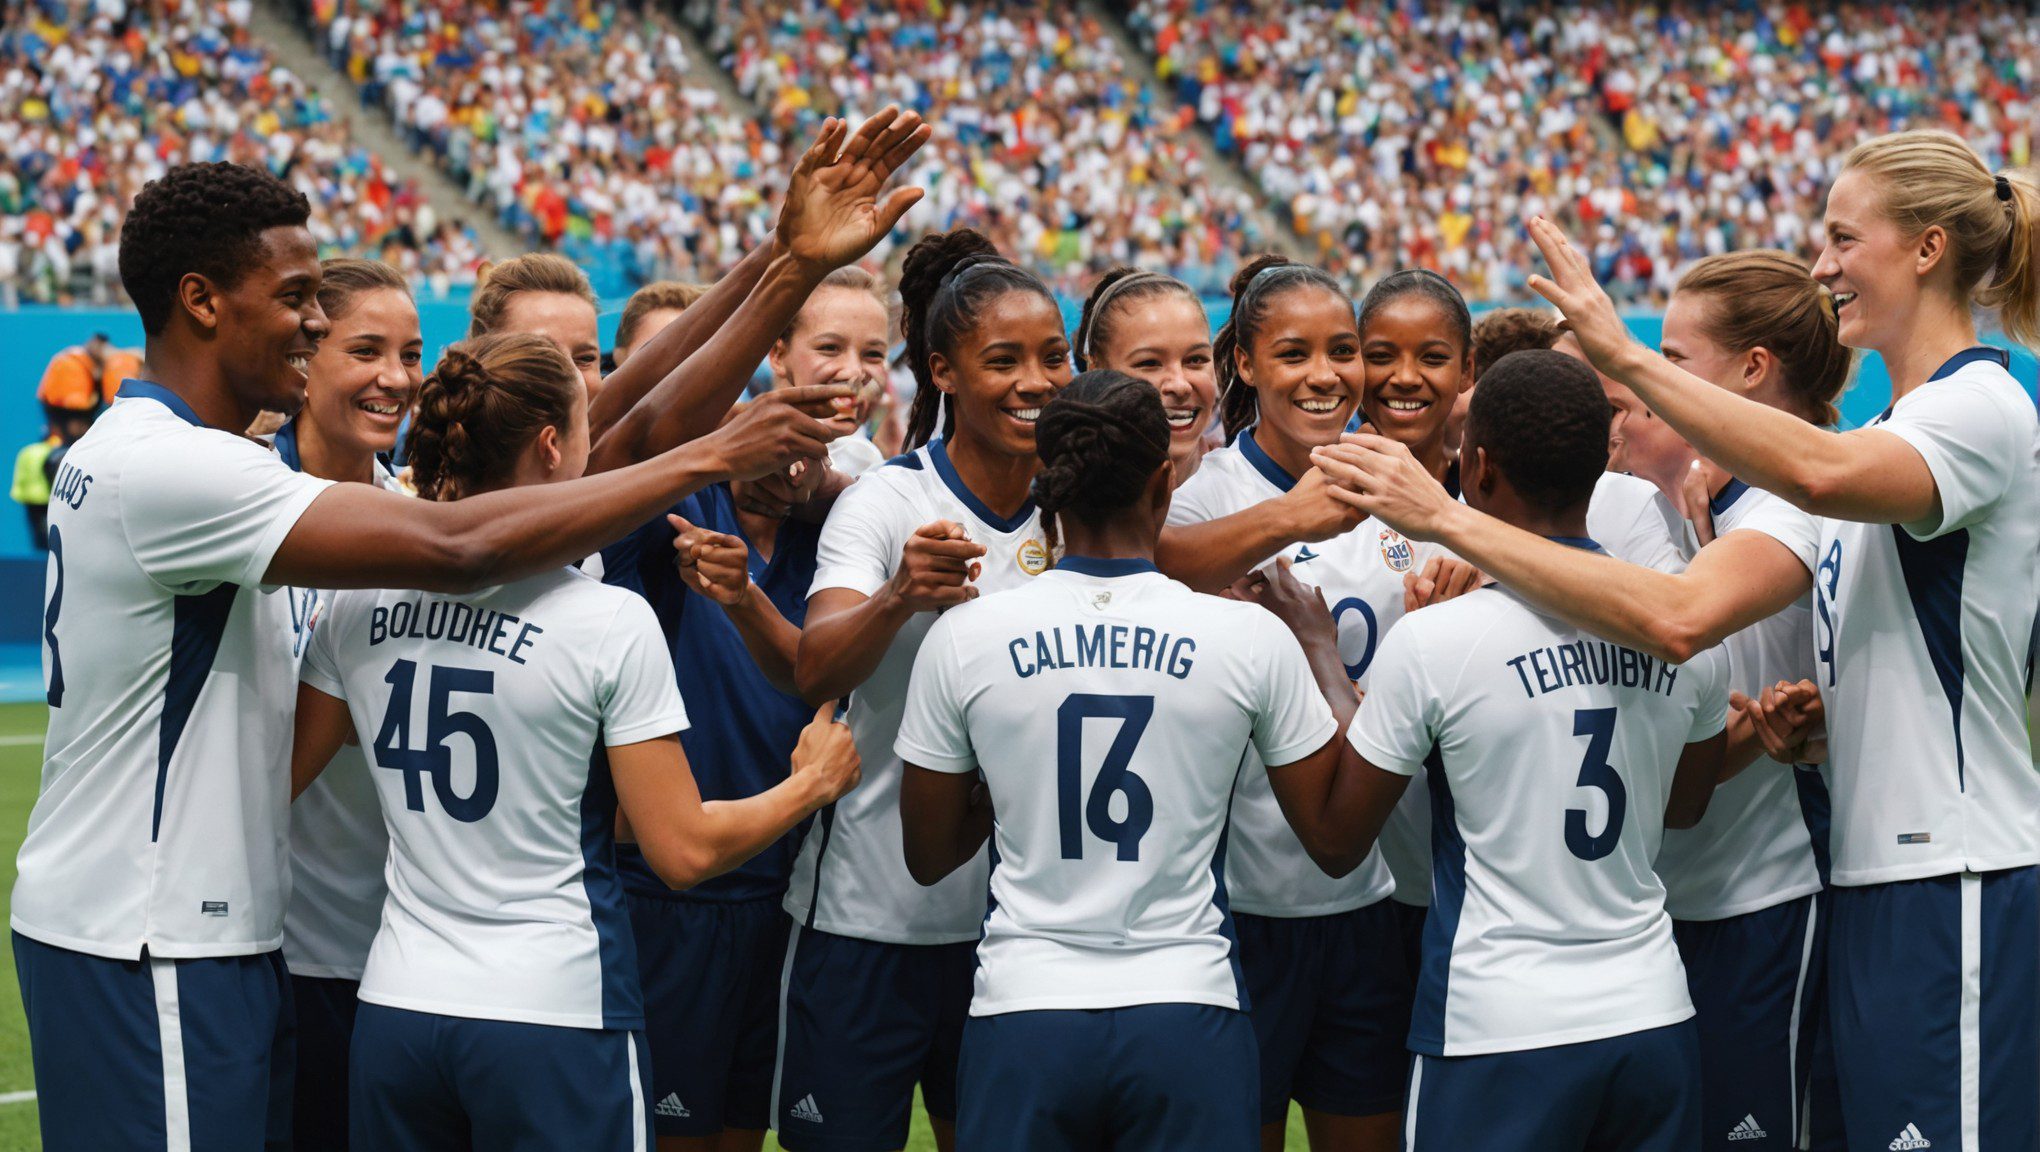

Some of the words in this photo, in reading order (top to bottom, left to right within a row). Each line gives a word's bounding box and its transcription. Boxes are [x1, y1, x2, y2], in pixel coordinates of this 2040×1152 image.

[370, 600, 544, 665] BOLUDHEE
[1008, 624, 1197, 680] CALMERIG
[373, 657, 500, 823] 45
[1563, 706, 1627, 861] 3
